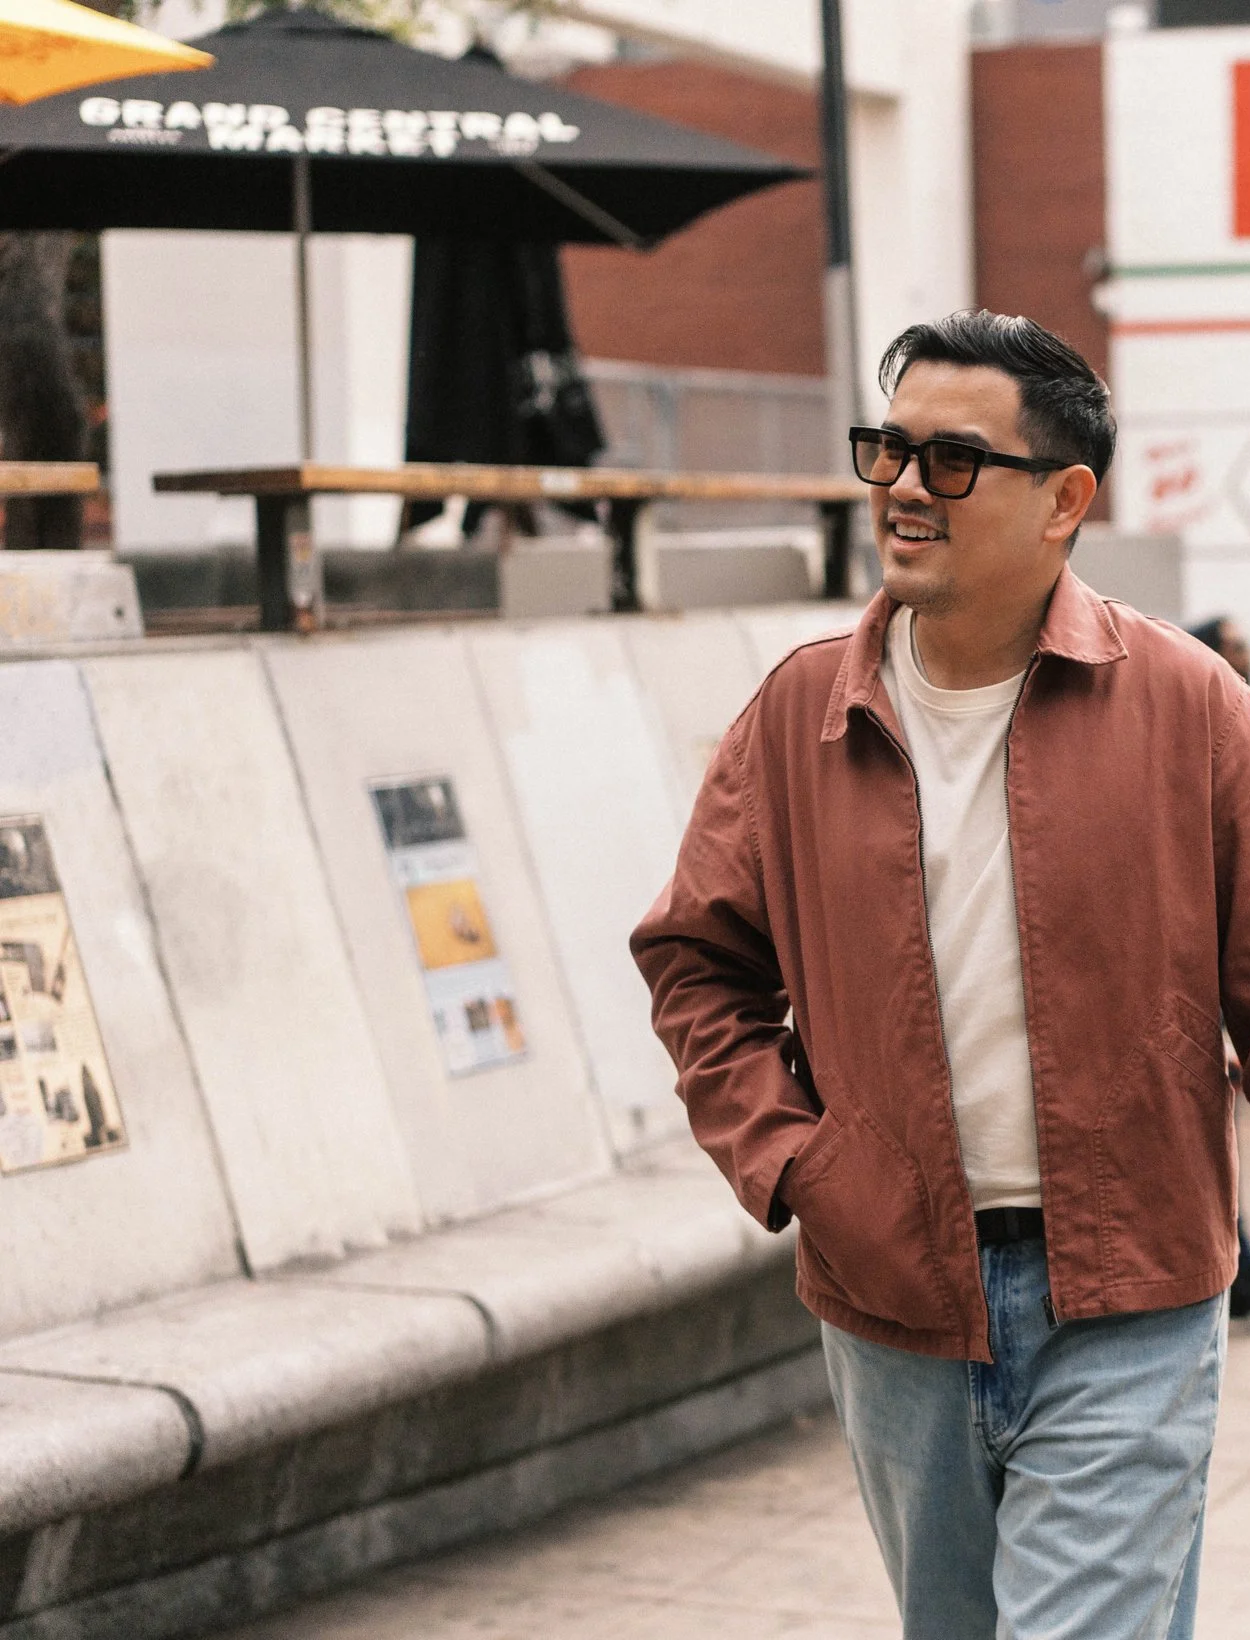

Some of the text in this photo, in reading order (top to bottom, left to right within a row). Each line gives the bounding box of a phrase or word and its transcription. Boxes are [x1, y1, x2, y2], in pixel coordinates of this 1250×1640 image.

[79, 97, 581, 144] GRAND CENTRAL
[207, 125, 463, 158] MARKET
